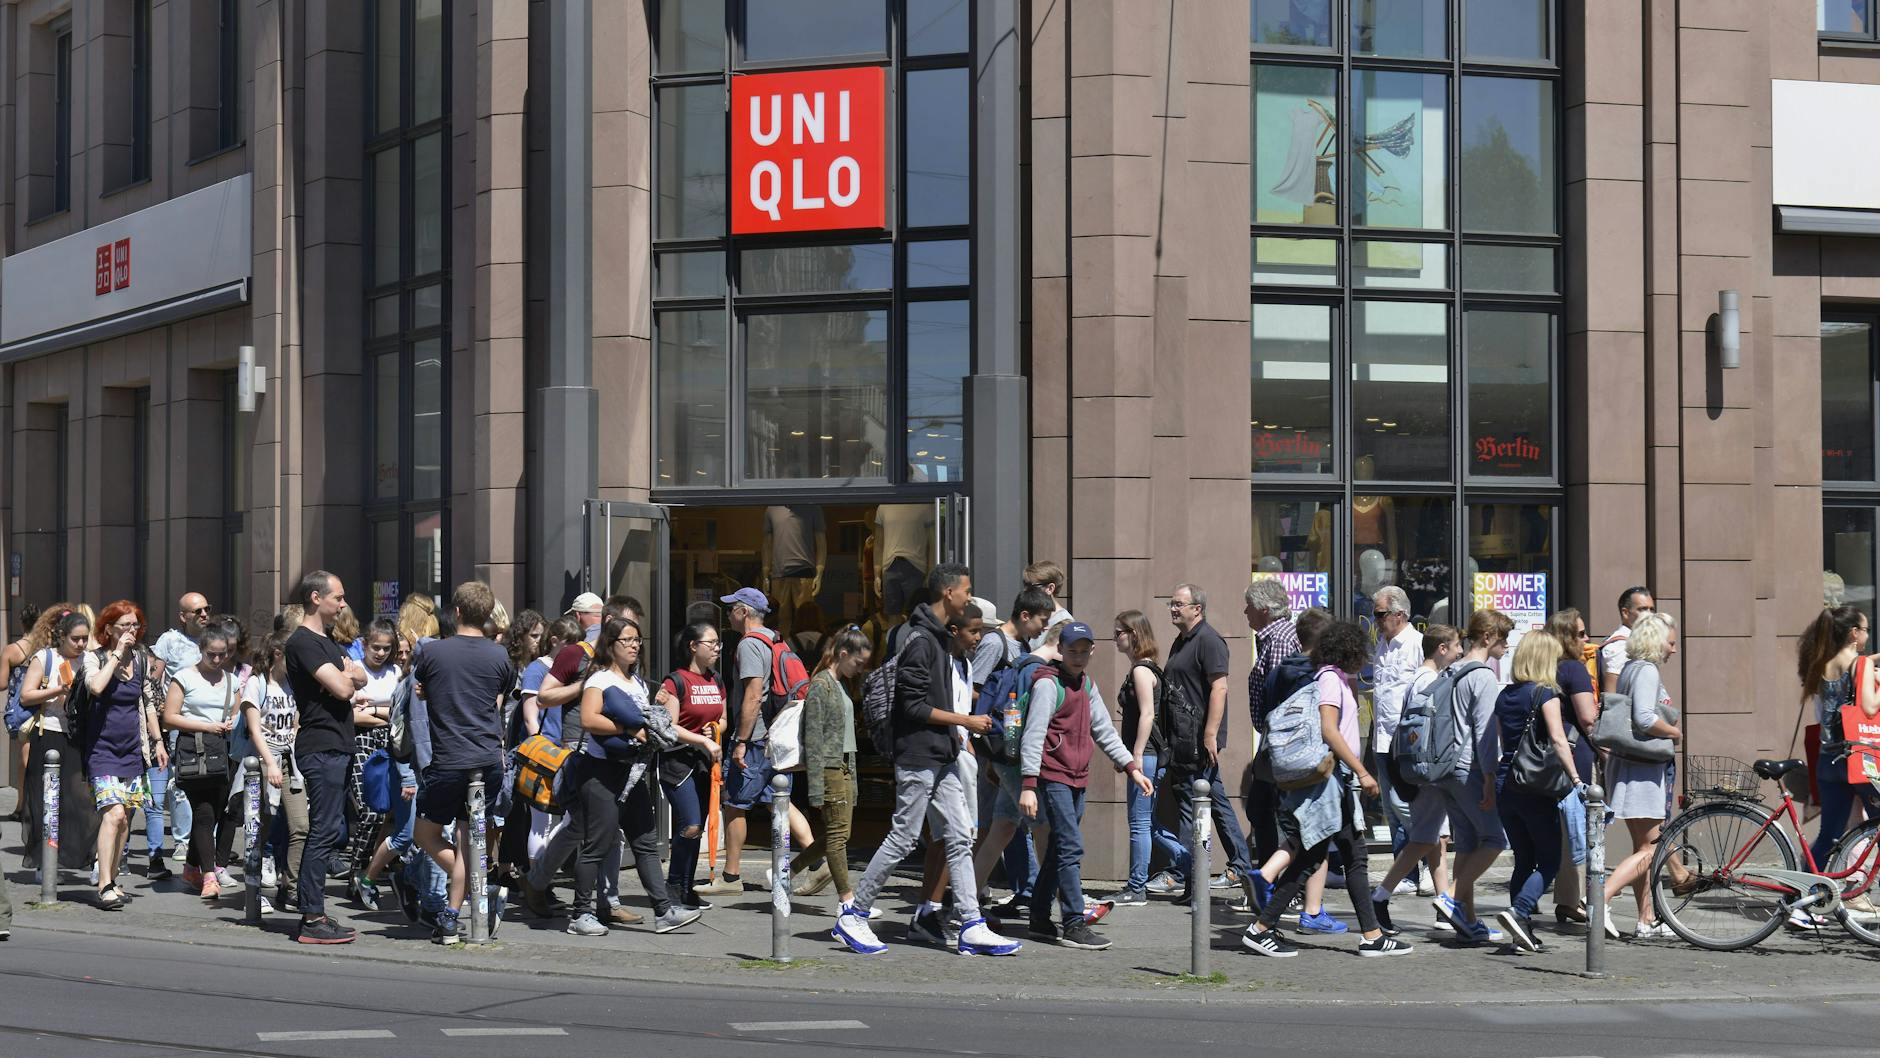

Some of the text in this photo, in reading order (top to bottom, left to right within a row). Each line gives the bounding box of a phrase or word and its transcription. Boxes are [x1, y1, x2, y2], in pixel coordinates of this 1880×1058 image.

[750, 90, 850, 146] UNI
[750, 155, 861, 221] QLO
[98, 251, 109, 269] ユニ
[116, 245, 128, 263] UNI
[97, 271, 110, 289] クロ
[116, 265, 128, 286] QLO
[1256, 432, 1322, 457] Berlin
[1475, 435, 1541, 461] Berlin
[1475, 574, 1545, 592] SOMMER
[1475, 594, 1545, 610] SPECIALS
